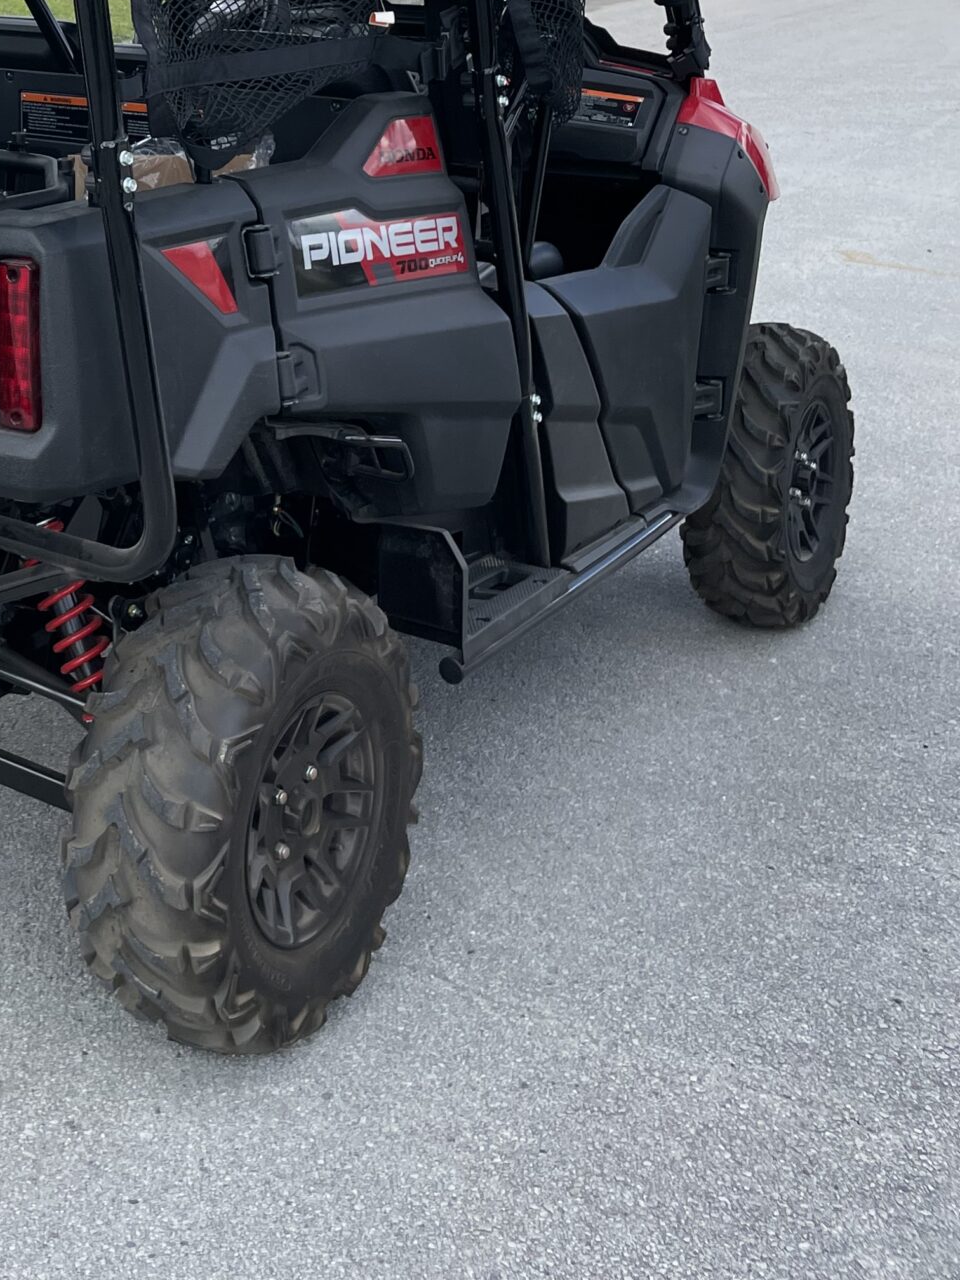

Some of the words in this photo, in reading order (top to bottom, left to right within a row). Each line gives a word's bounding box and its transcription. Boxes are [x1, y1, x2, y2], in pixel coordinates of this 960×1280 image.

[380, 147, 436, 164] HONDA
[300, 216, 459, 270] PIONEER
[396, 258, 429, 274] 700
